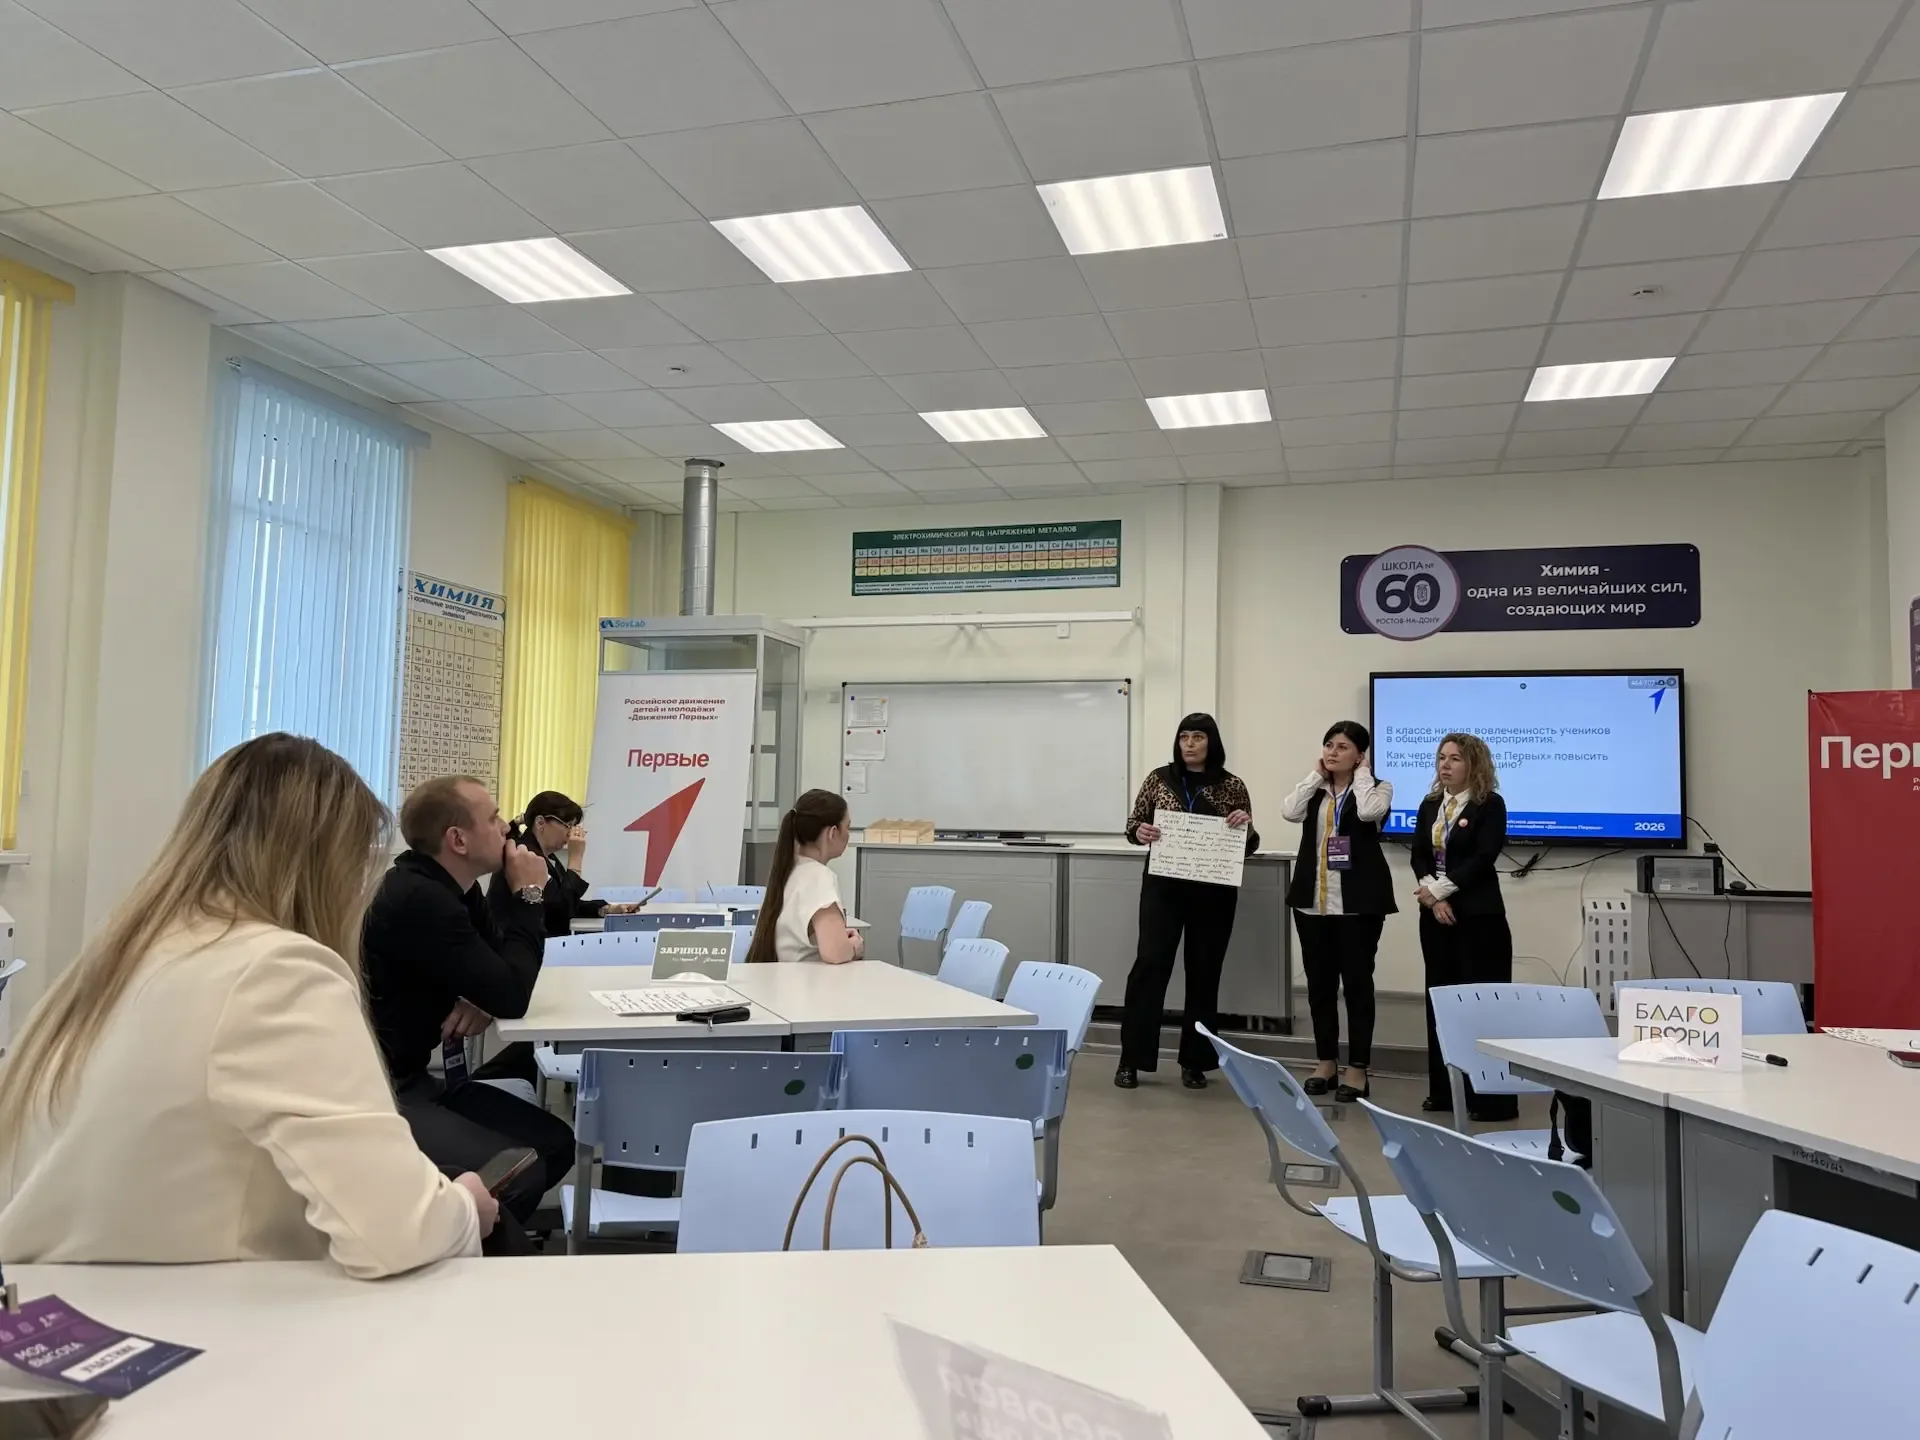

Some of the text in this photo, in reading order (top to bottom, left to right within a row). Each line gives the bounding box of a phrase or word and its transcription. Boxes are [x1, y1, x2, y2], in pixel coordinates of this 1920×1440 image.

[892, 525, 1077, 541] ЭЛЕКТРОХИМИЧЕСКИЙ РЯД НАПРЯЖЕНИЙ МЕТАЛЛОВ
[1381, 561, 1423, 571] ШКОЛА
[1540, 564, 1599, 577] Химия
[414, 578, 495, 610] ХИМИЯ
[1375, 573, 1441, 614] 60
[1466, 581, 1687, 598] одна из величайших сил,
[1506, 602, 1646, 617] создающих мир
[1375, 617, 1440, 625] РОСТОВ-НА-ДОНУ
[624, 697, 726, 707] Российское движение
[633, 705, 659, 714] детей
[668, 704, 715, 713] молодёжи
[628, 713, 677, 722] «Движение
[1386, 726, 1393, 734] В
[1396, 726, 1432, 735] классе
[1474, 726, 1557, 735] вовлеченность
[1559, 726, 1611, 736] учеников
[627, 749, 709, 771] Первые
[1386, 751, 1406, 760] Как
[1504, 751, 1551, 761] Первых»
[1554, 752, 1609, 762] повысить
[1634, 822, 1666, 832] 2026
[659, 947, 727, 957] ЗАРНИЦА 2.0
[1636, 1002, 1719, 1025] БЛАГО
